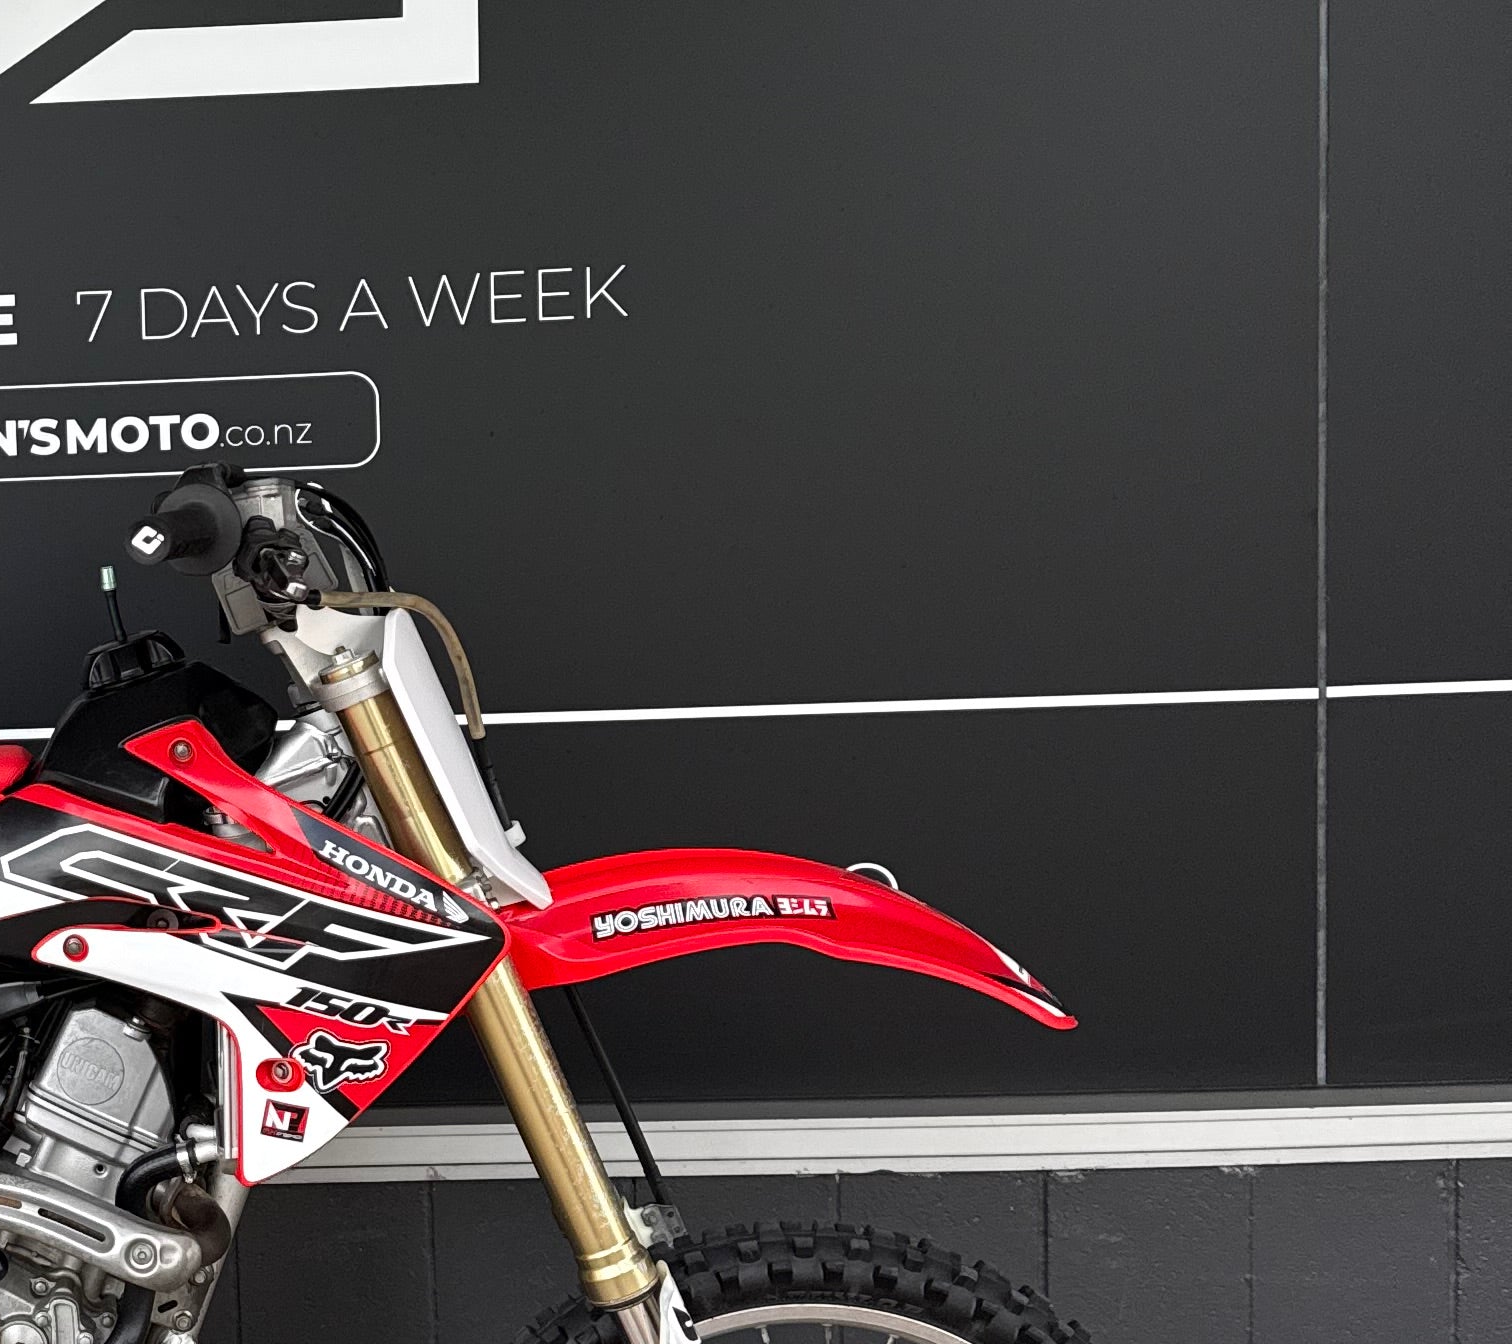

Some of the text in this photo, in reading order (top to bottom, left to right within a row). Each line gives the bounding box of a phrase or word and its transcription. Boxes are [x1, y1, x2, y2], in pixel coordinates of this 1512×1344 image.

[76, 289, 113, 343] 7
[140, 281, 319, 341] DAYS
[339, 278, 389, 332] A
[407, 264, 629, 327] WEEK
[319, 839, 437, 911] HONDA
[593, 896, 775, 940] YOSHIMURA
